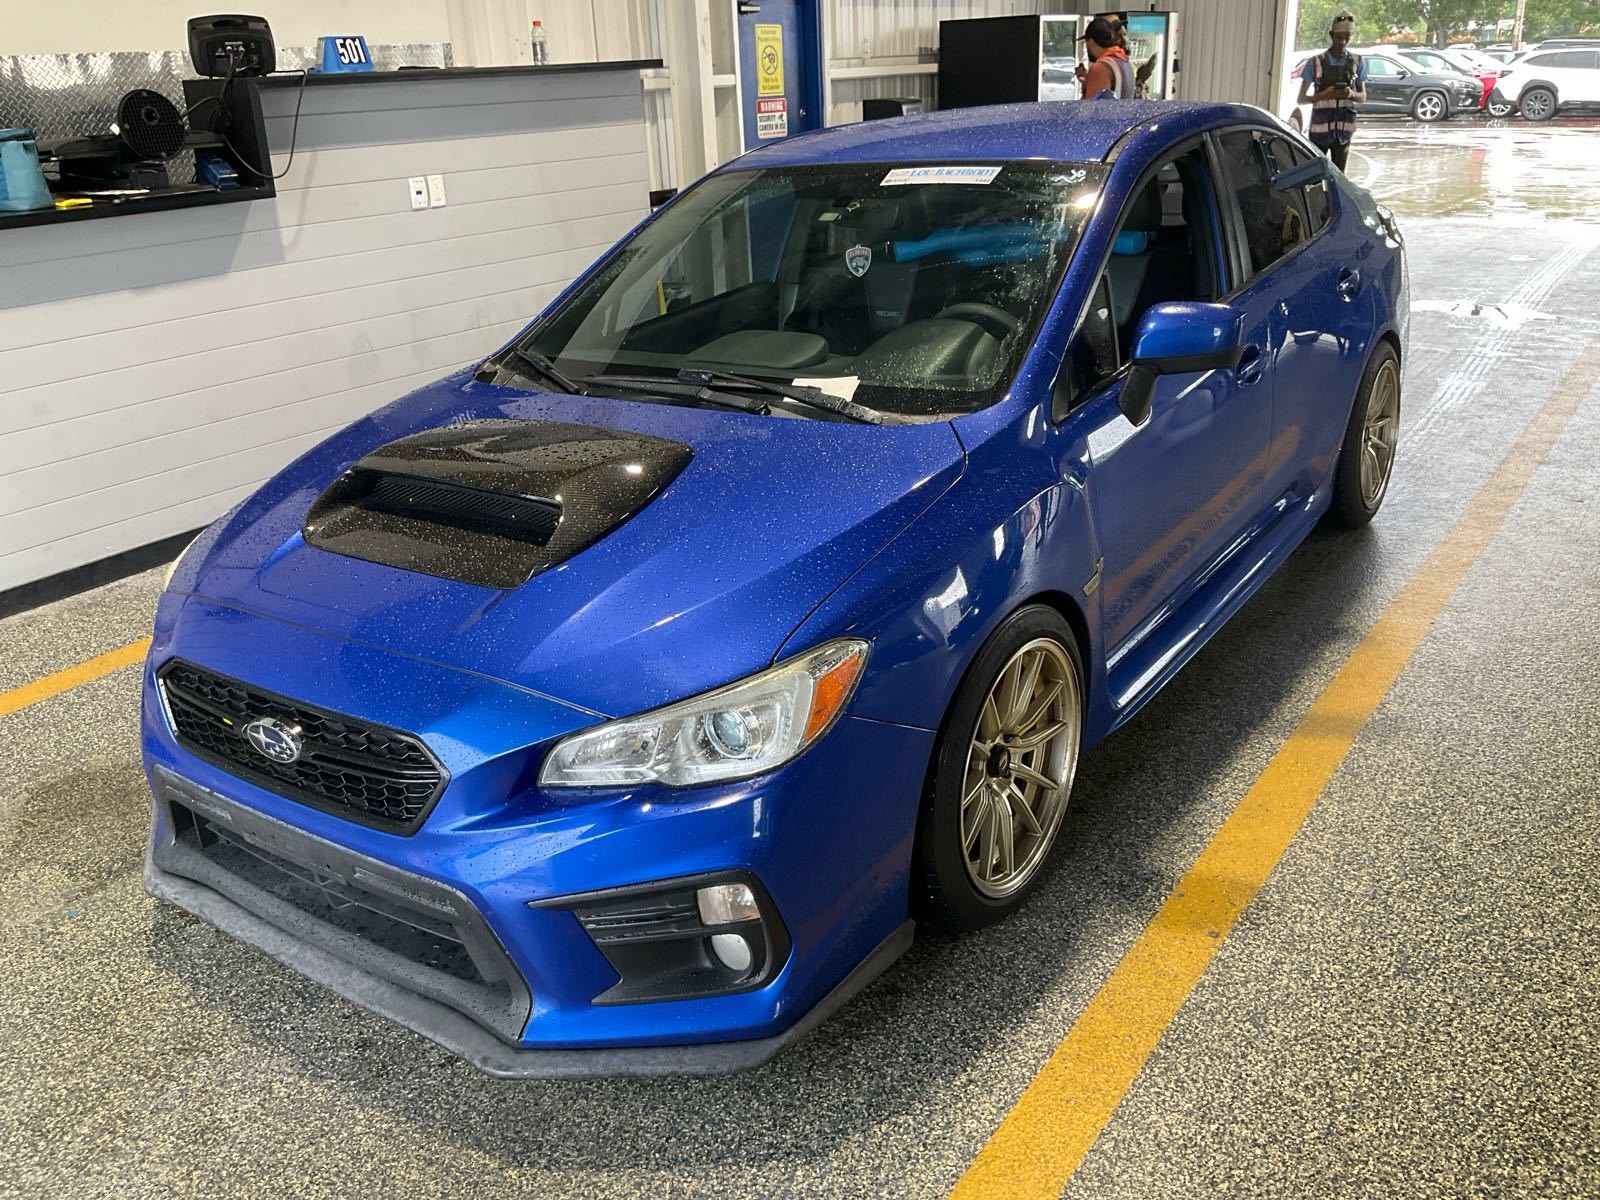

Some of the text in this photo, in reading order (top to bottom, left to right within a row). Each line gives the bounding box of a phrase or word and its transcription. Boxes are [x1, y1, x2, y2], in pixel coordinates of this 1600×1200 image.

[335, 38, 366, 64] 501
[760, 100, 784, 112] WARNING
[759, 123, 774, 131] CAMERA
